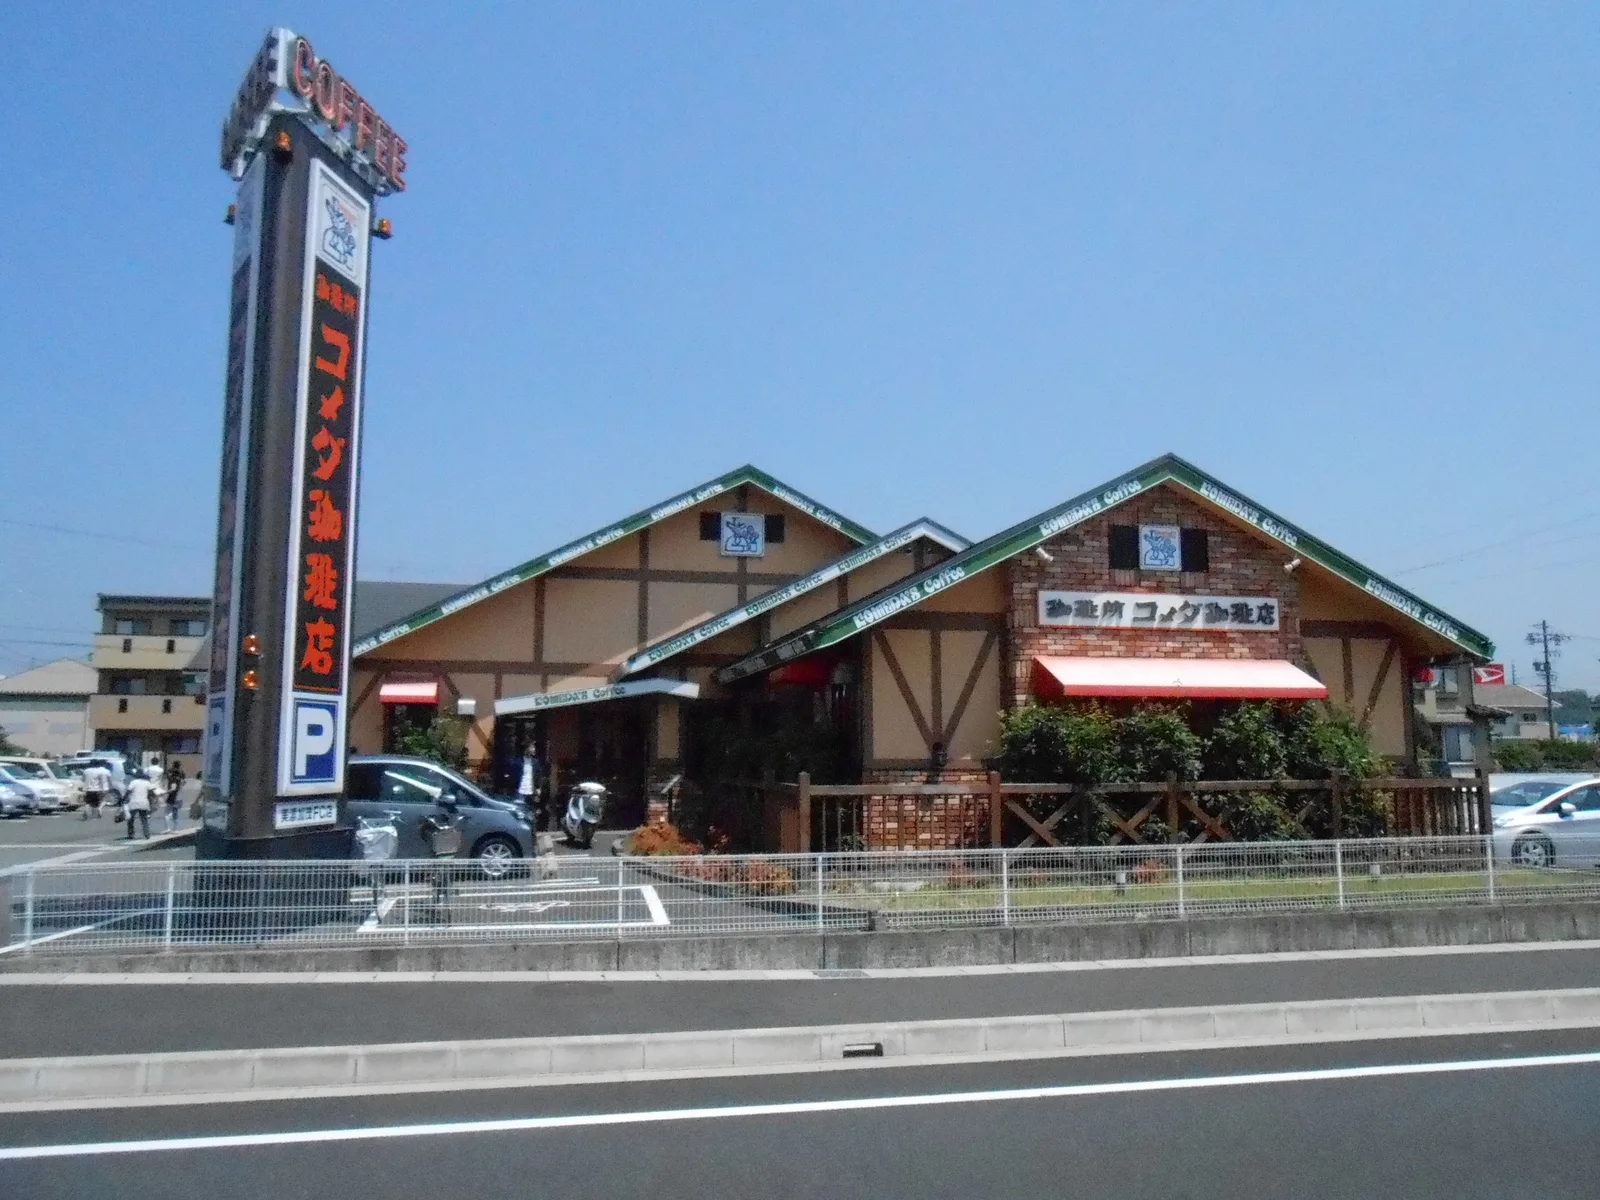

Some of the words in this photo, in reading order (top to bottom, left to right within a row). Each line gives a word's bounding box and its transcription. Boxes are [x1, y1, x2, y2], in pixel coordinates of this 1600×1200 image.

[293, 36, 409, 191] COFFEE
[300, 323, 351, 675] コメダ珈琲店
[1039, 498, 1101, 537] KOMEDA'S
[1103, 480, 1142, 506] Coffee
[1199, 481, 1258, 524] KOMEDA'S
[1262, 516, 1298, 546] Coffee
[794, 575, 823, 592] Coffee
[853, 586, 921, 628] KOMEDA'S
[923, 566, 966, 597] Coffee
[1132, 600, 1276, 626] コメダ珈琲店
[1365, 577, 1421, 619] KOMEDA'S
[1424, 612, 1459, 640] Coffee
[648, 633, 697, 662] KOMEDA'S
[699, 618, 730, 637] Coffee
[535, 690, 588, 706] KOMEDA'S
[593, 686, 626, 699] Coffee
[295, 706, 335, 777] P
